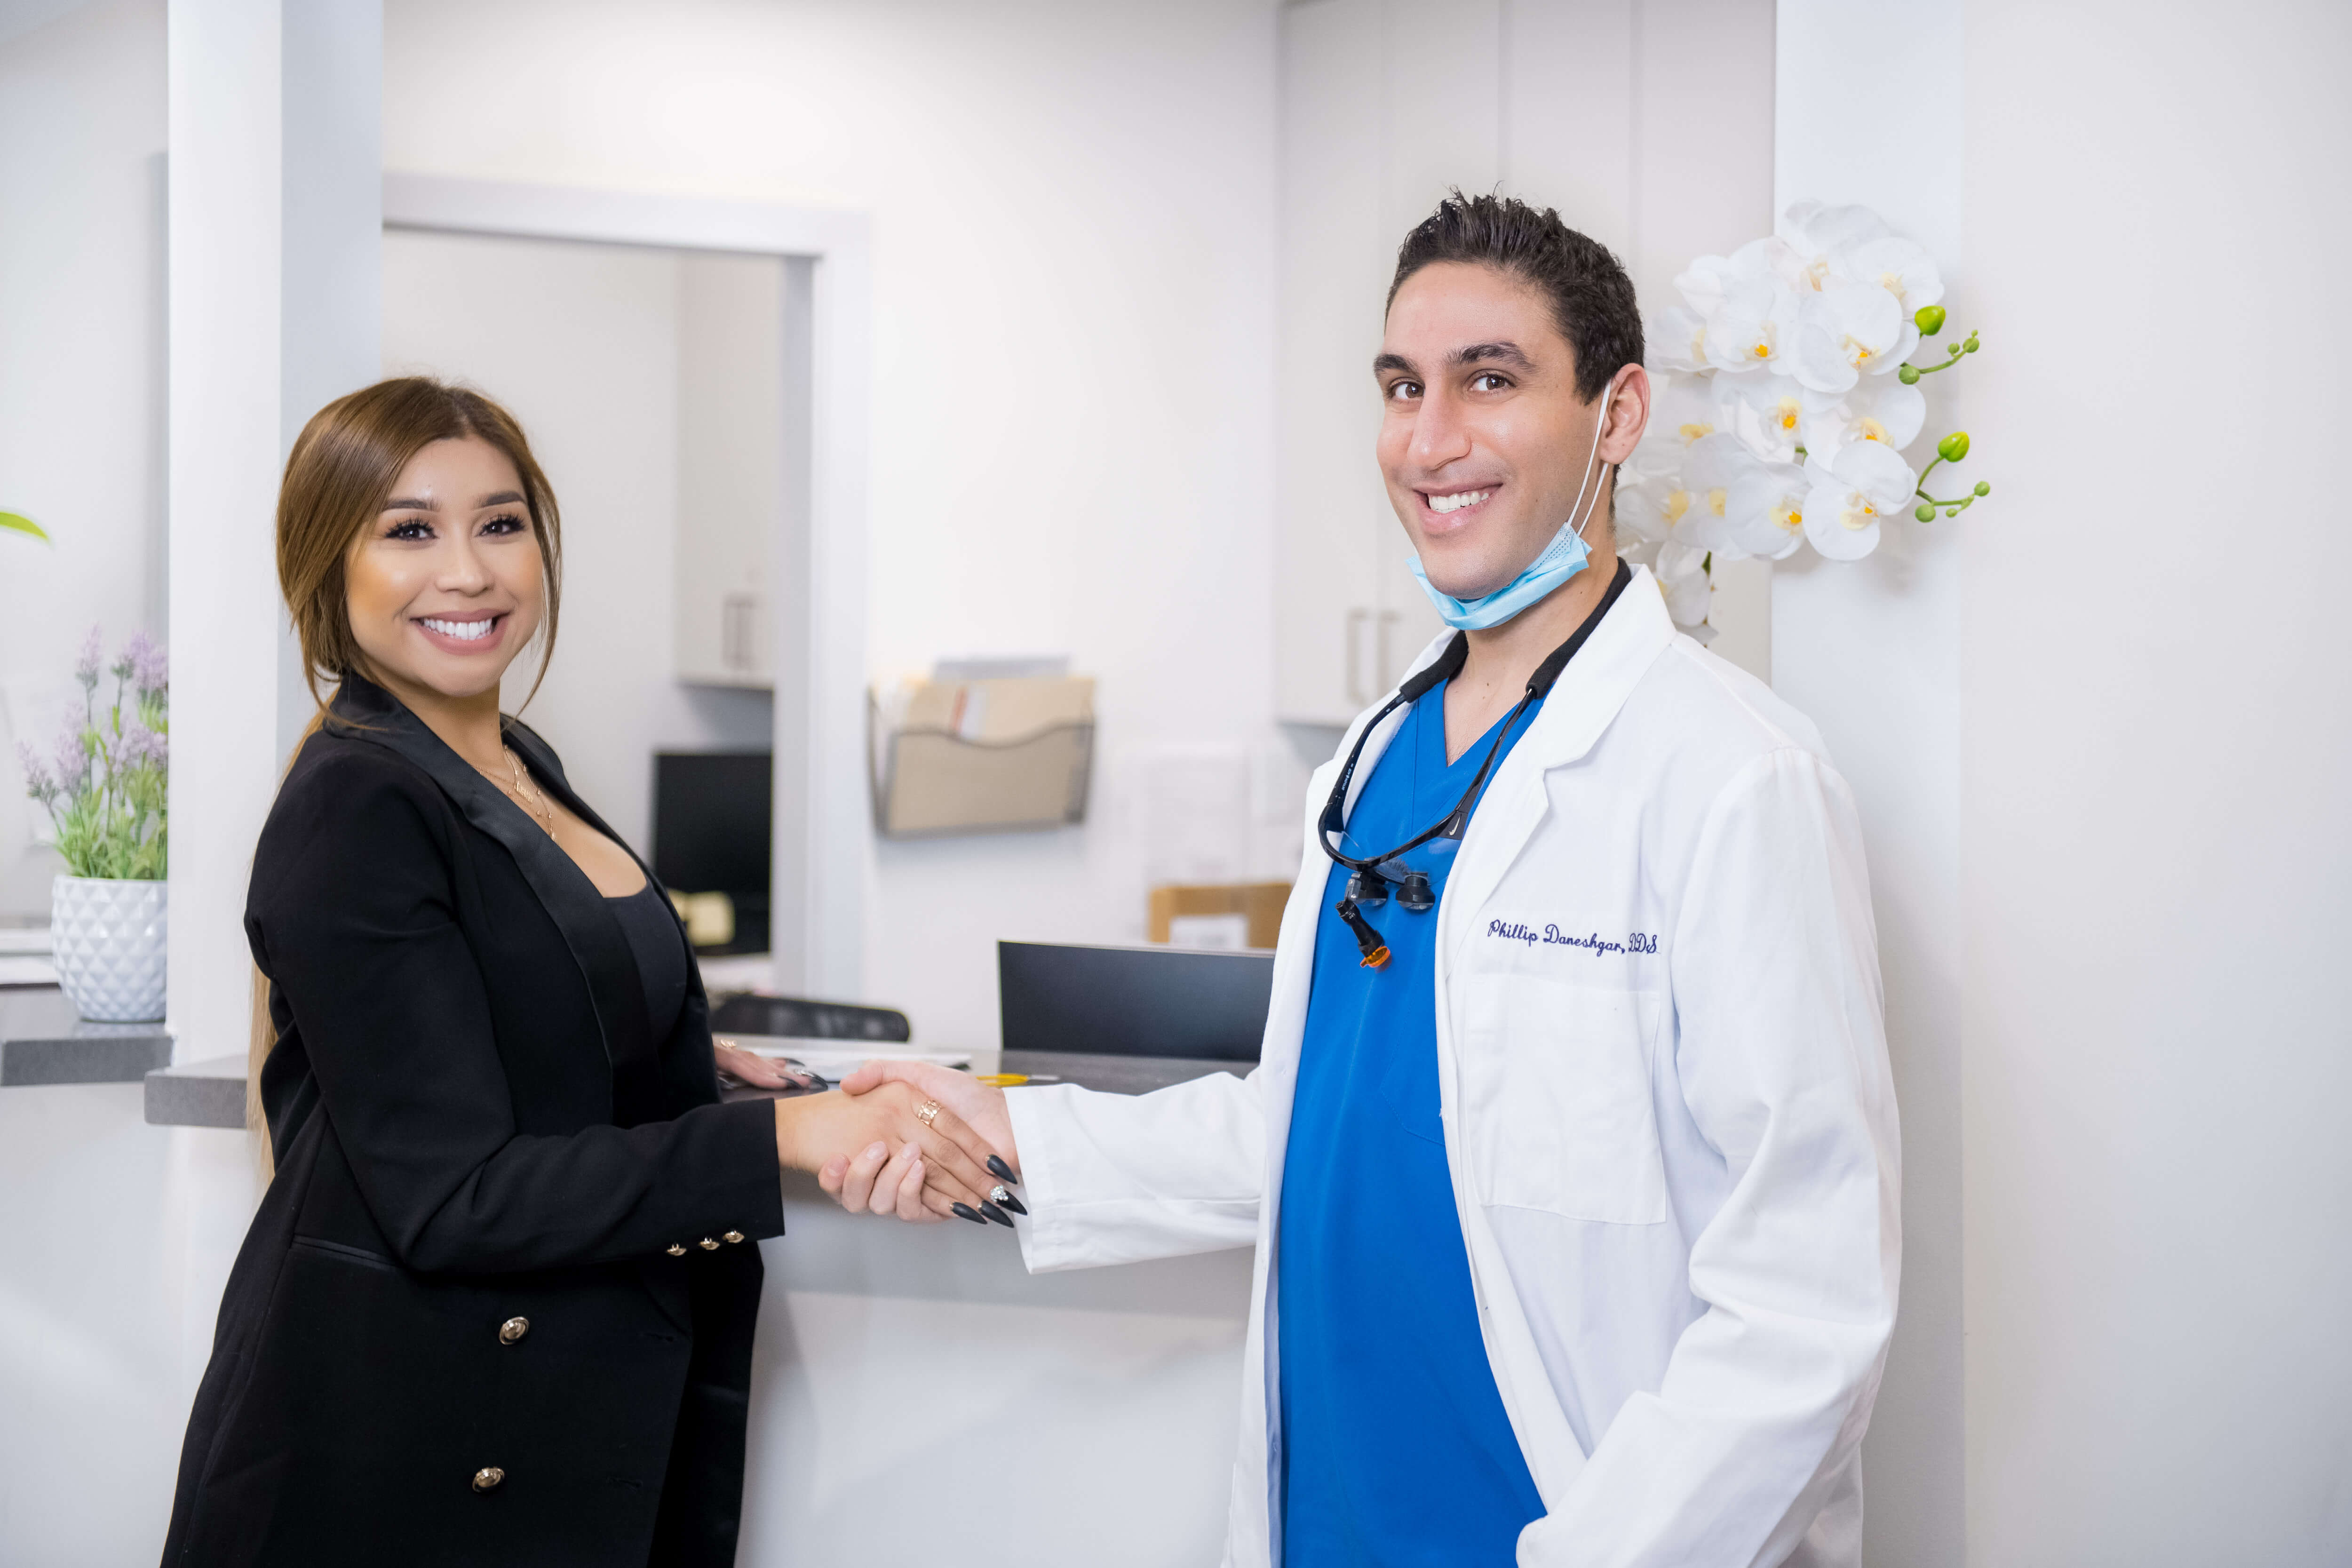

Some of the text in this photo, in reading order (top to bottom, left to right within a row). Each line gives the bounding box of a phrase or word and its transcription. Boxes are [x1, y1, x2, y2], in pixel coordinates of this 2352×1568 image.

[1488, 919, 1658, 957] Phillip Daneshgar, DDS
